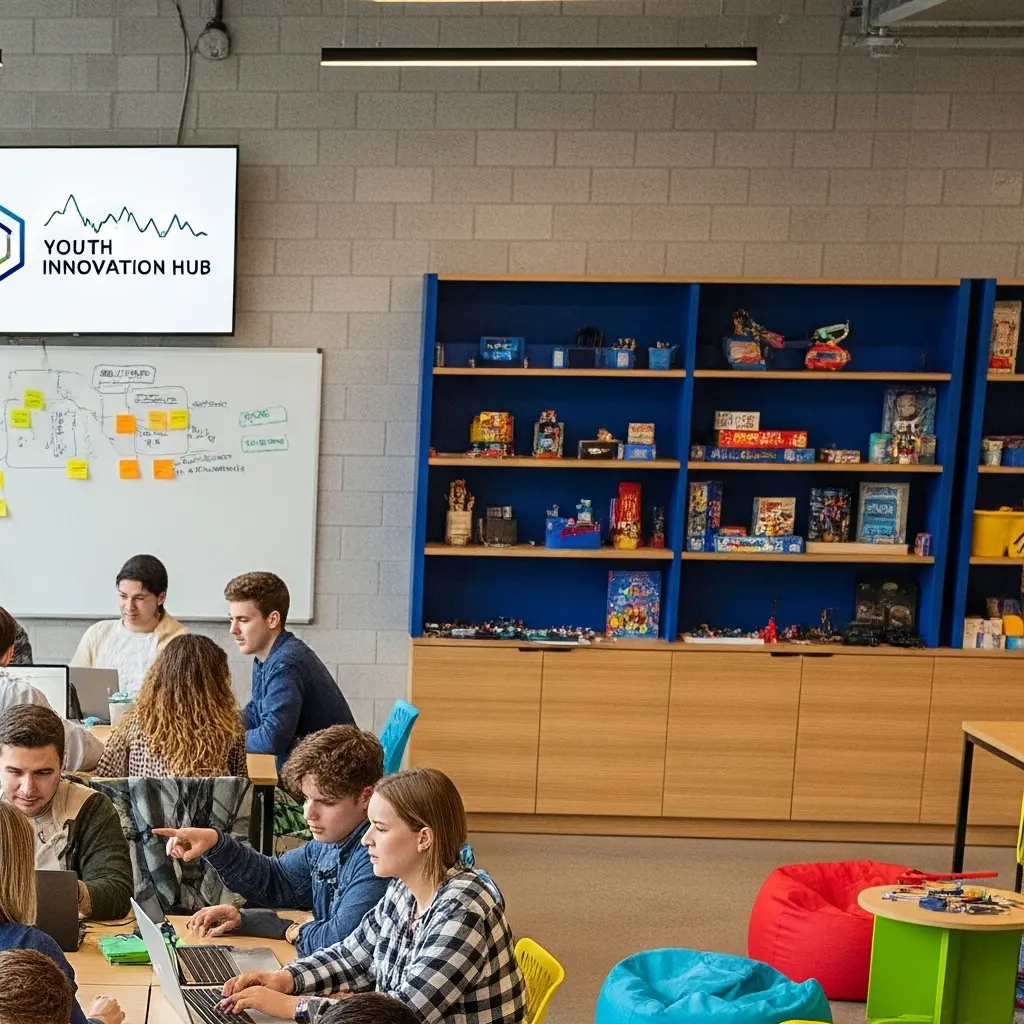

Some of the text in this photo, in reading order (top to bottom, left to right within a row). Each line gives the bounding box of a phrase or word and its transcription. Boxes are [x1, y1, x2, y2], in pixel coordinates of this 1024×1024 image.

[43, 239, 113, 255] YOUTH
[42, 259, 211, 276] INNOVATION HUB
